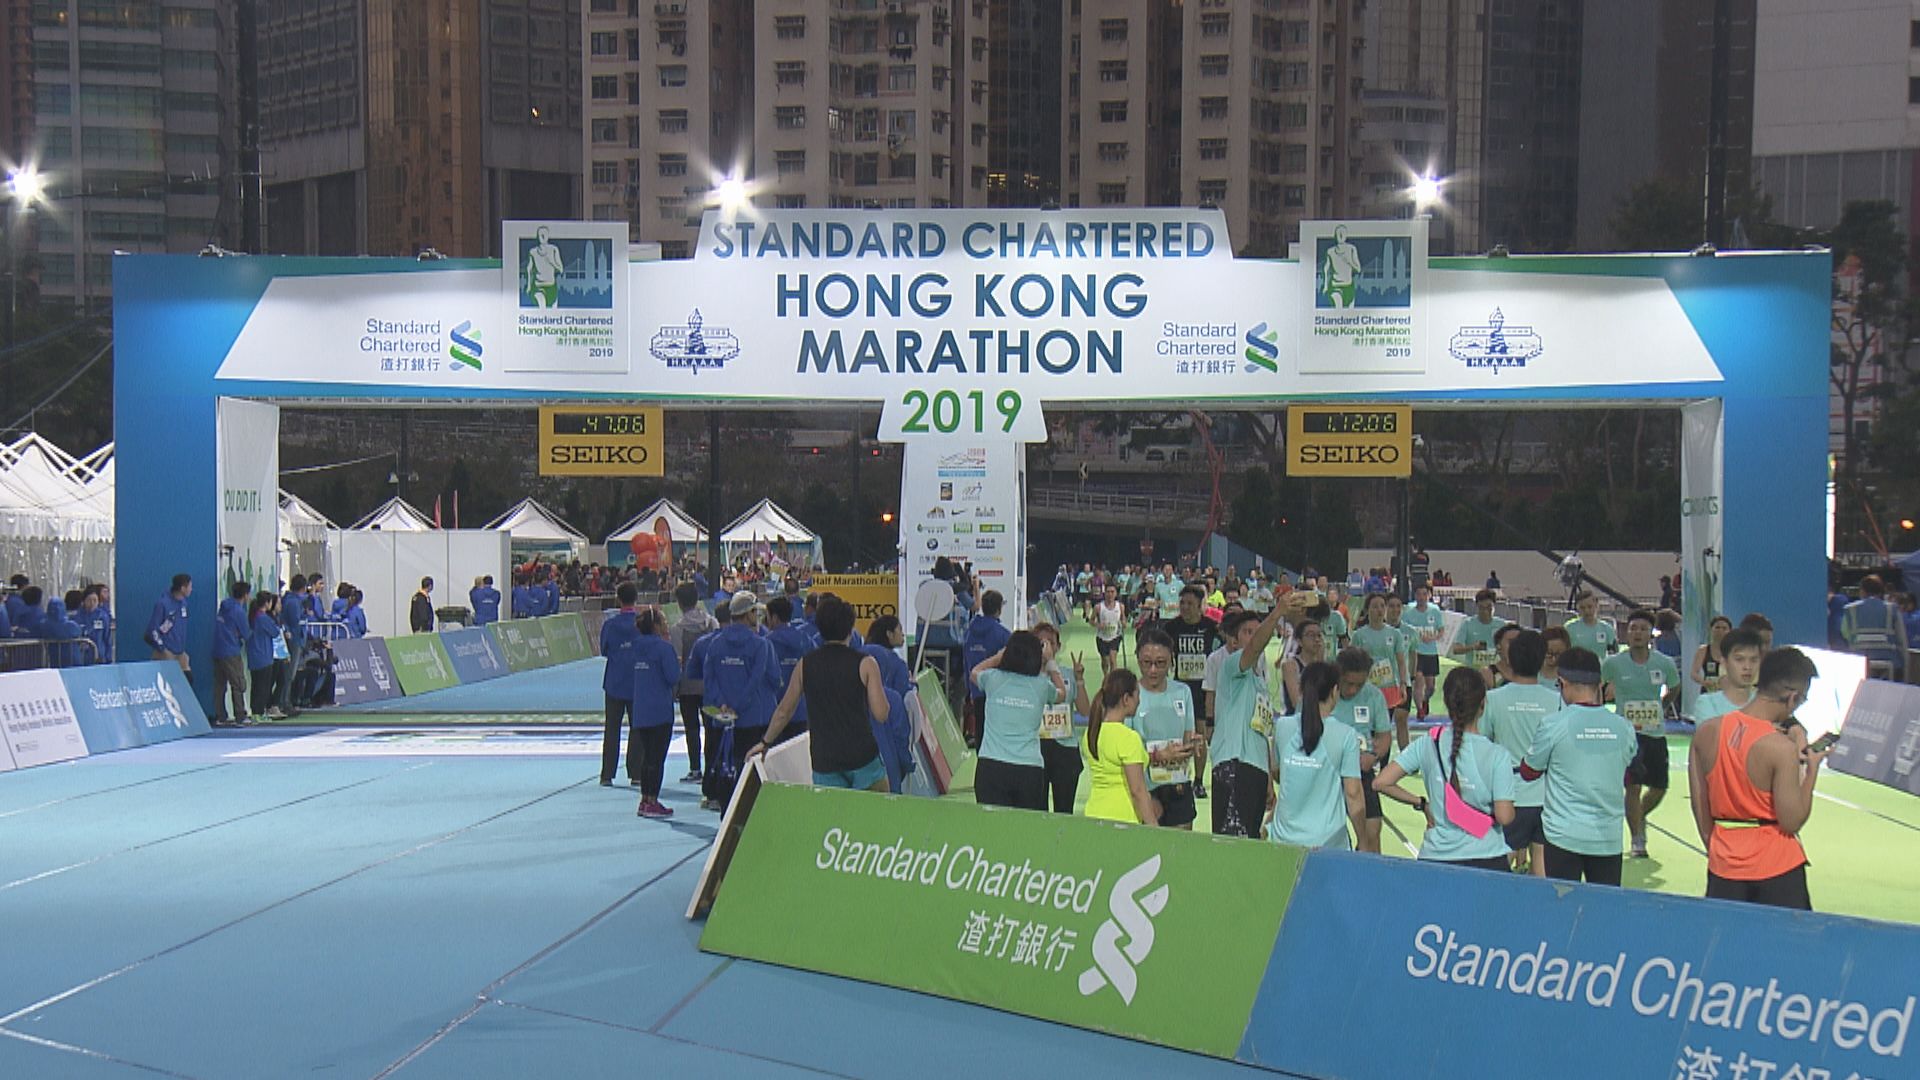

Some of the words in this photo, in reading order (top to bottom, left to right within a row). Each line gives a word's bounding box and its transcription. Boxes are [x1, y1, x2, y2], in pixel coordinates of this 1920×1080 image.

[713, 221, 947, 258] STANDARD
[962, 221, 1216, 259] CHARTERED
[776, 272, 953, 319] HONG
[975, 272, 1149, 319] KONG
[366, 318, 441, 335] Standard
[518, 315, 562, 326] Standard
[564, 315, 614, 326] Chartered
[1314, 315, 1360, 326] Standard
[1360, 315, 1411, 326] Chartered
[518, 326, 543, 338] Hong
[543, 326, 568, 338] Kong
[568, 326, 614, 336] Marathon
[1163, 321, 1237, 338] Standard
[1314, 326, 1339, 338] Hong
[1339, 326, 1365, 338] Kong
[1365, 326, 1411, 336] Marathon
[359, 336, 441, 353] Chartered
[588, 347, 614, 358] 2019
[796, 329, 1123, 375] MARATHON
[1156, 340, 1237, 356] Chartered
[1385, 347, 1411, 358] 2019
[380, 356, 441, 372] 渣打銀行
[1176, 359, 1237, 375] 渣打銀行
[900, 389, 1022, 434] 2019
[550, 445, 648, 464] SEIKO
[1300, 445, 1400, 464] SEIKO
[812, 576, 831, 585] Half
[834, 576, 878, 585] Marathon
[1178, 637, 1205, 653] HKG
[816, 827, 949, 886] Standard
[945, 844, 1103, 914] Chartered
[957, 909, 1078, 972] 渣打銀行
[1406, 923, 1627, 1008] Standard
[1631, 957, 1916, 1057] Chartered
